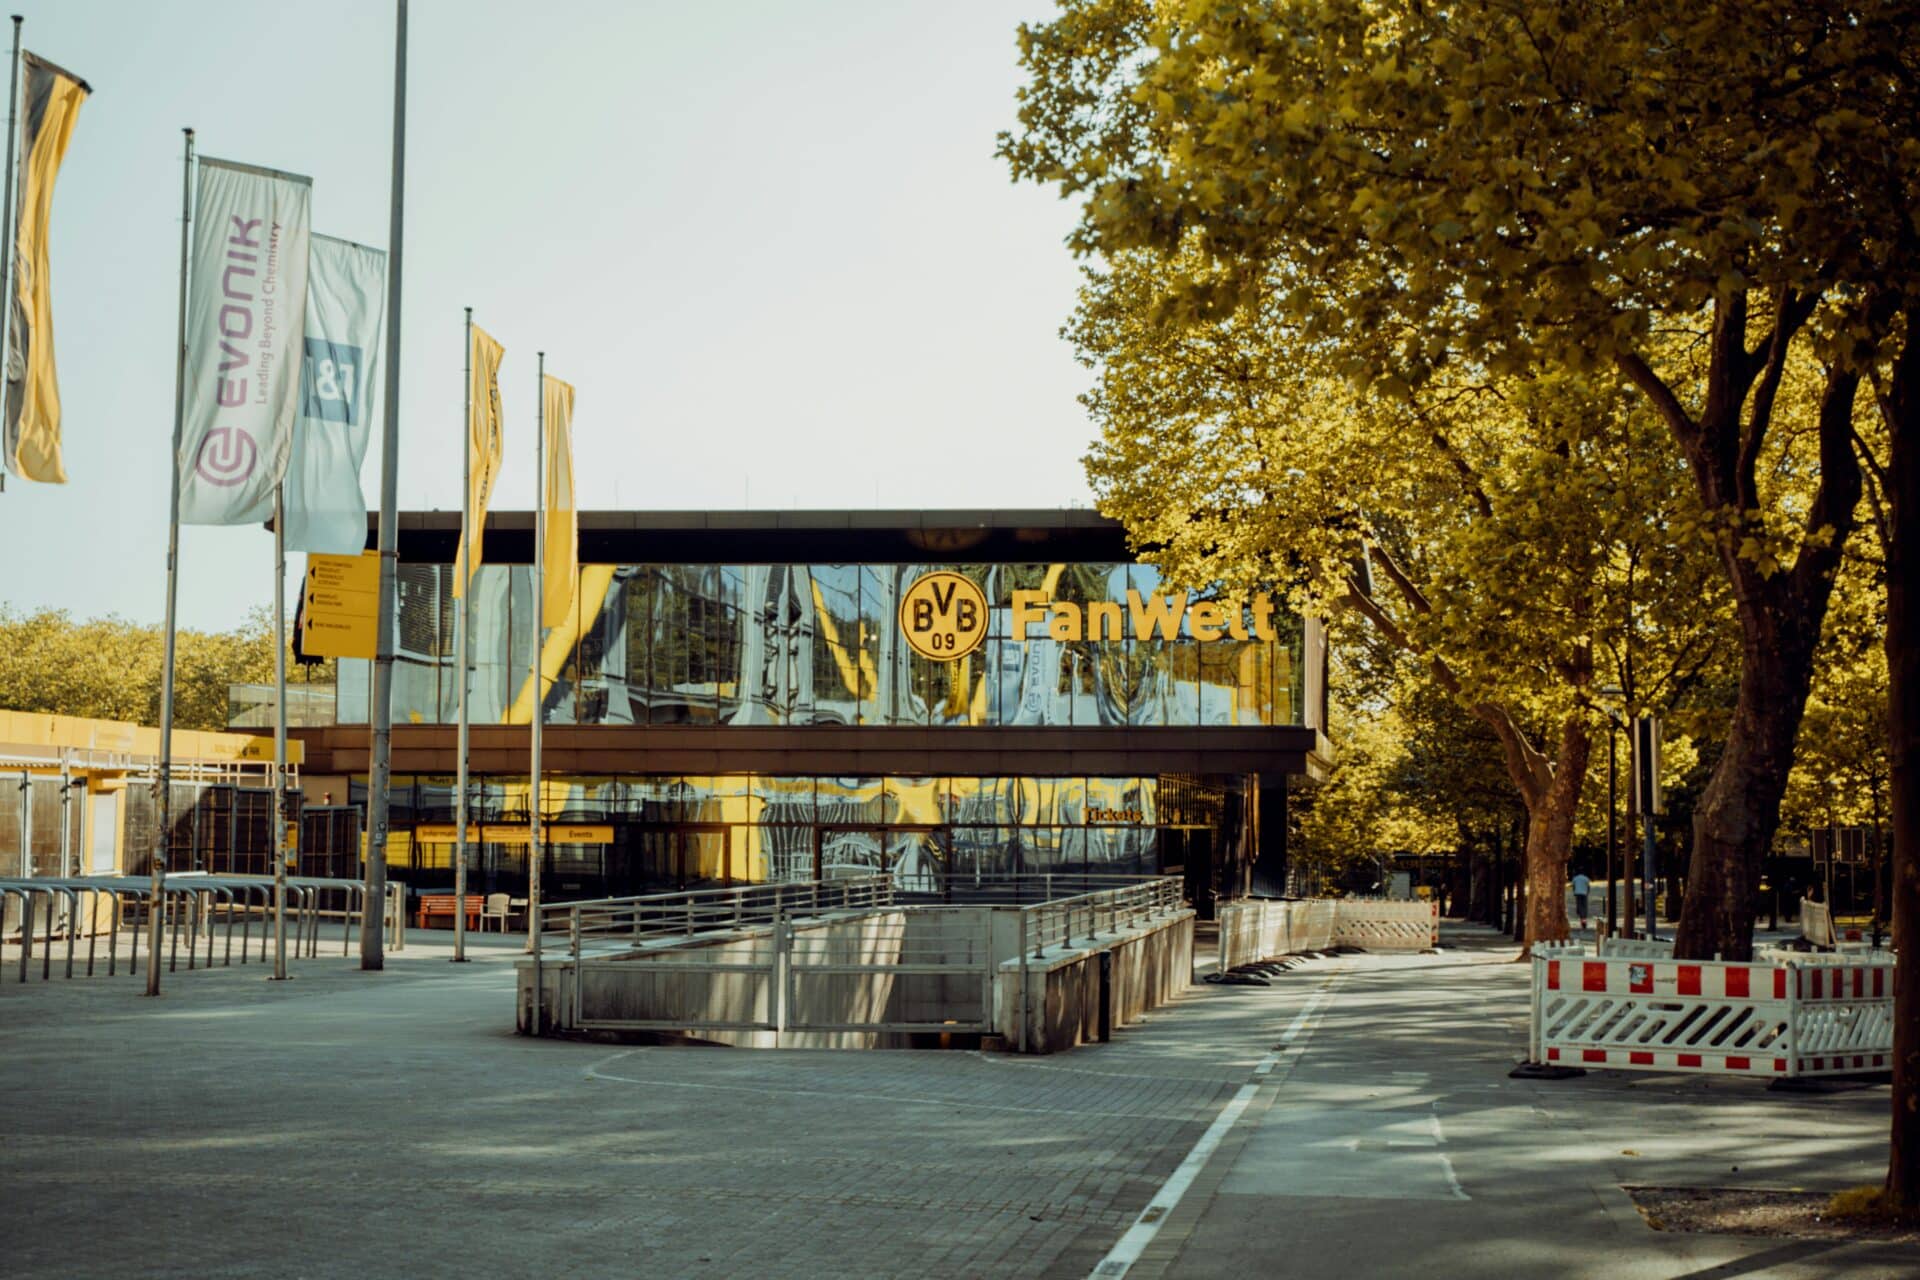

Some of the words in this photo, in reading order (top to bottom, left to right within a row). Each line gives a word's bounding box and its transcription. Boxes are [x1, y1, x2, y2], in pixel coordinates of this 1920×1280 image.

[262, 221, 283, 295] Chemistry
[216, 214, 262, 408] EVONIK
[258, 299, 276, 349] Beyond
[256, 351, 274, 405] Leading
[913, 582, 977, 632] BVB
[1011, 589, 1275, 641] FanWelt
[931, 633, 955, 650] 09
[568, 830, 593, 839] Events
[1082, 808, 1142, 822] Tickets
